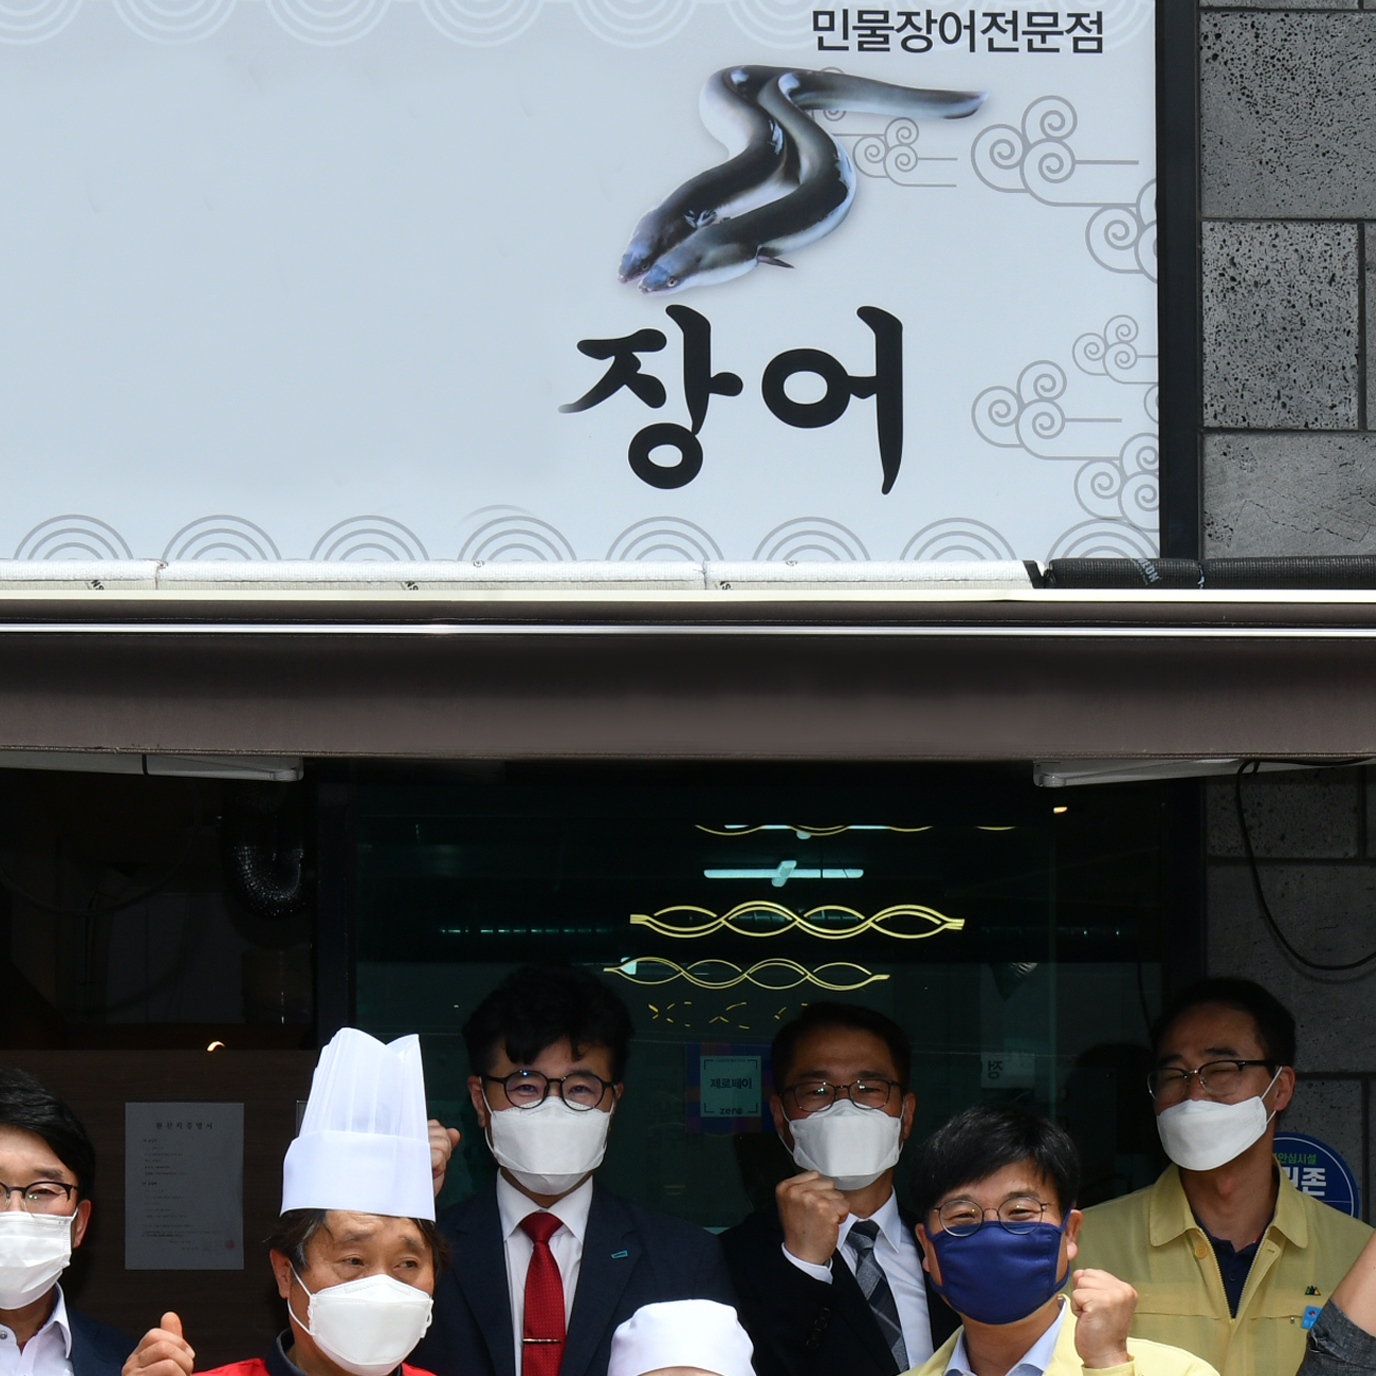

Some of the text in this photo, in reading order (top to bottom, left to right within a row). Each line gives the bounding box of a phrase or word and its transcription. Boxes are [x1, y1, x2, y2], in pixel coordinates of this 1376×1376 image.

[811, 9, 1105, 54] 민물장어전문점
[558, 304, 904, 496] 장어
[710, 1078, 753, 1090] 제로페이
